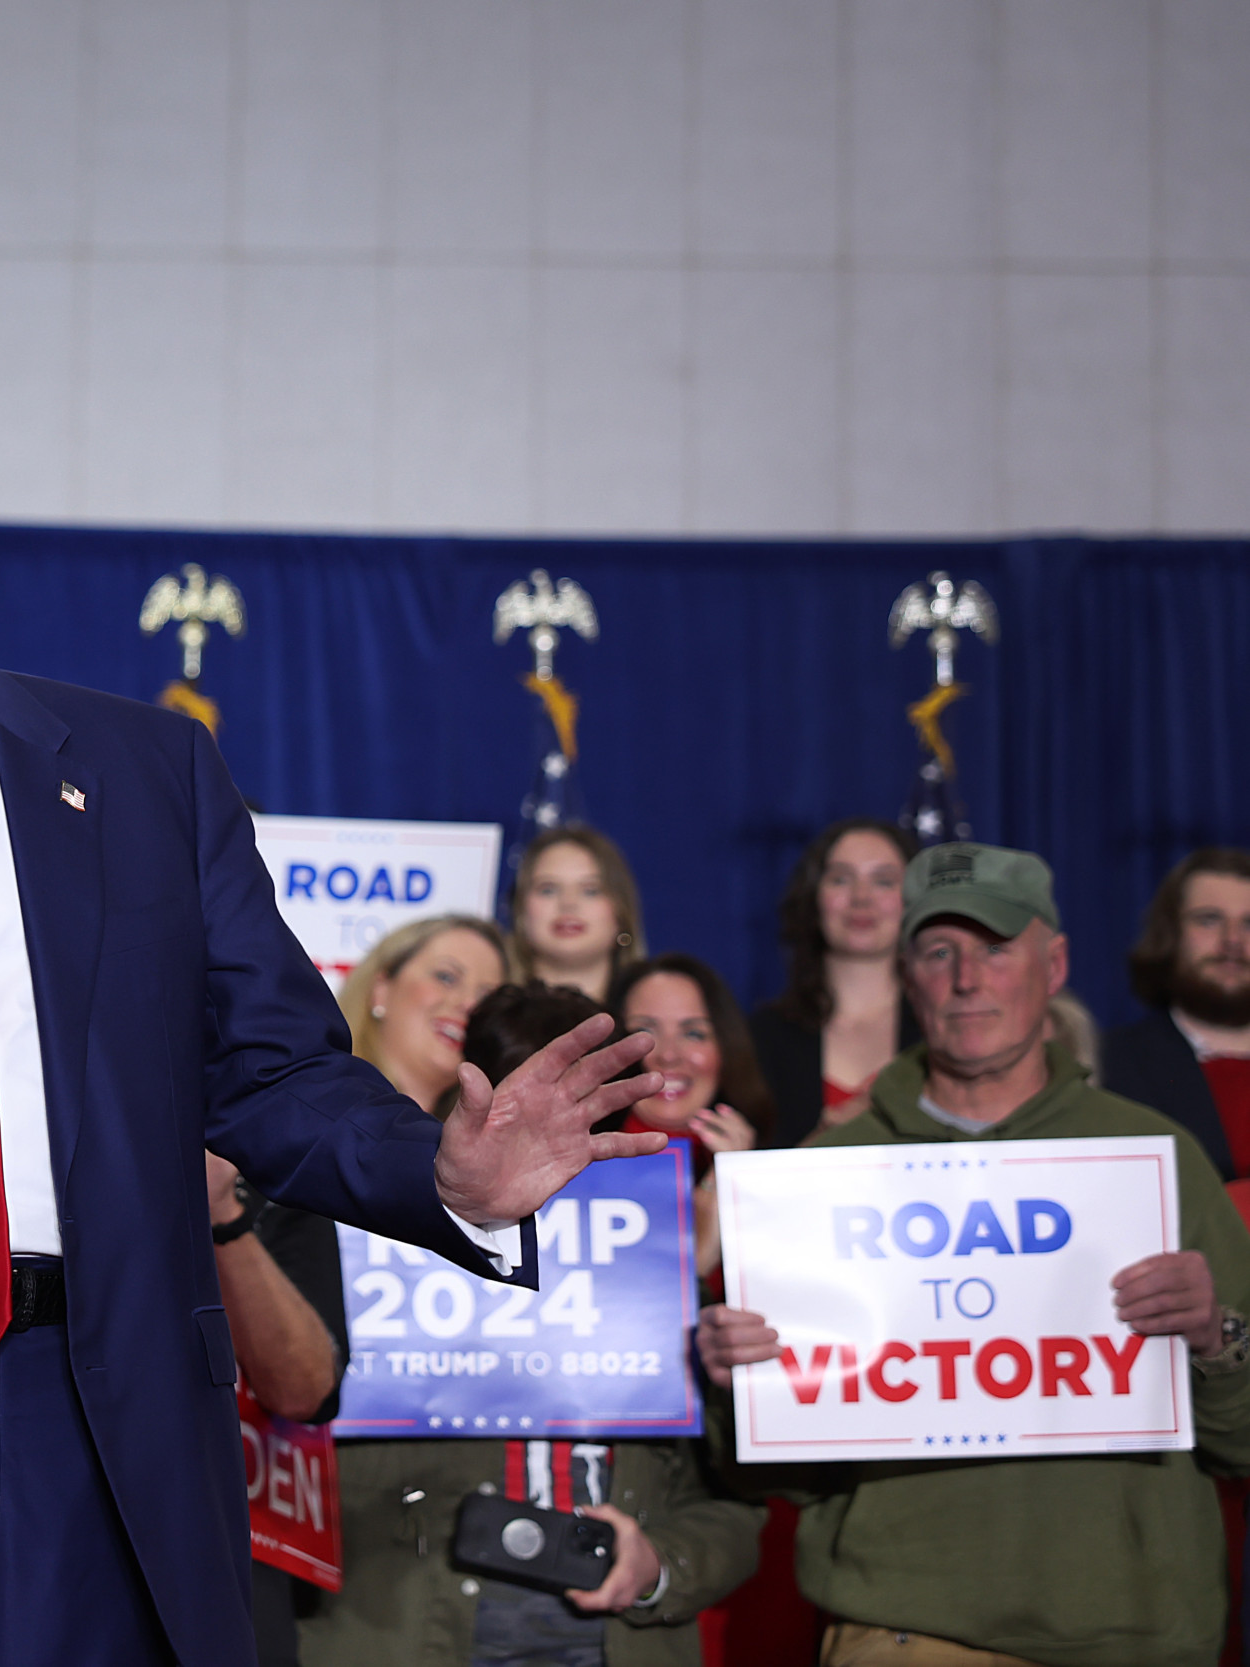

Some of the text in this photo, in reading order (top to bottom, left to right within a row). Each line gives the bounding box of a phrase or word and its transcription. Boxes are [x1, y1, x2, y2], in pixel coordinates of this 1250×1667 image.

[285, 863, 433, 903] ROAD
[335, 914, 387, 950] TO
[831, 1197, 1073, 1259] ROAD
[351, 1269, 601, 1339] 2024
[920, 1277, 996, 1320] TO
[385, 1350, 500, 1377] TRUMP
[508, 1351, 551, 1377] TO
[560, 1351, 662, 1376] 88022
[777, 1332, 1146, 1404] VICTORY
[240, 1421, 324, 1533] DEN
